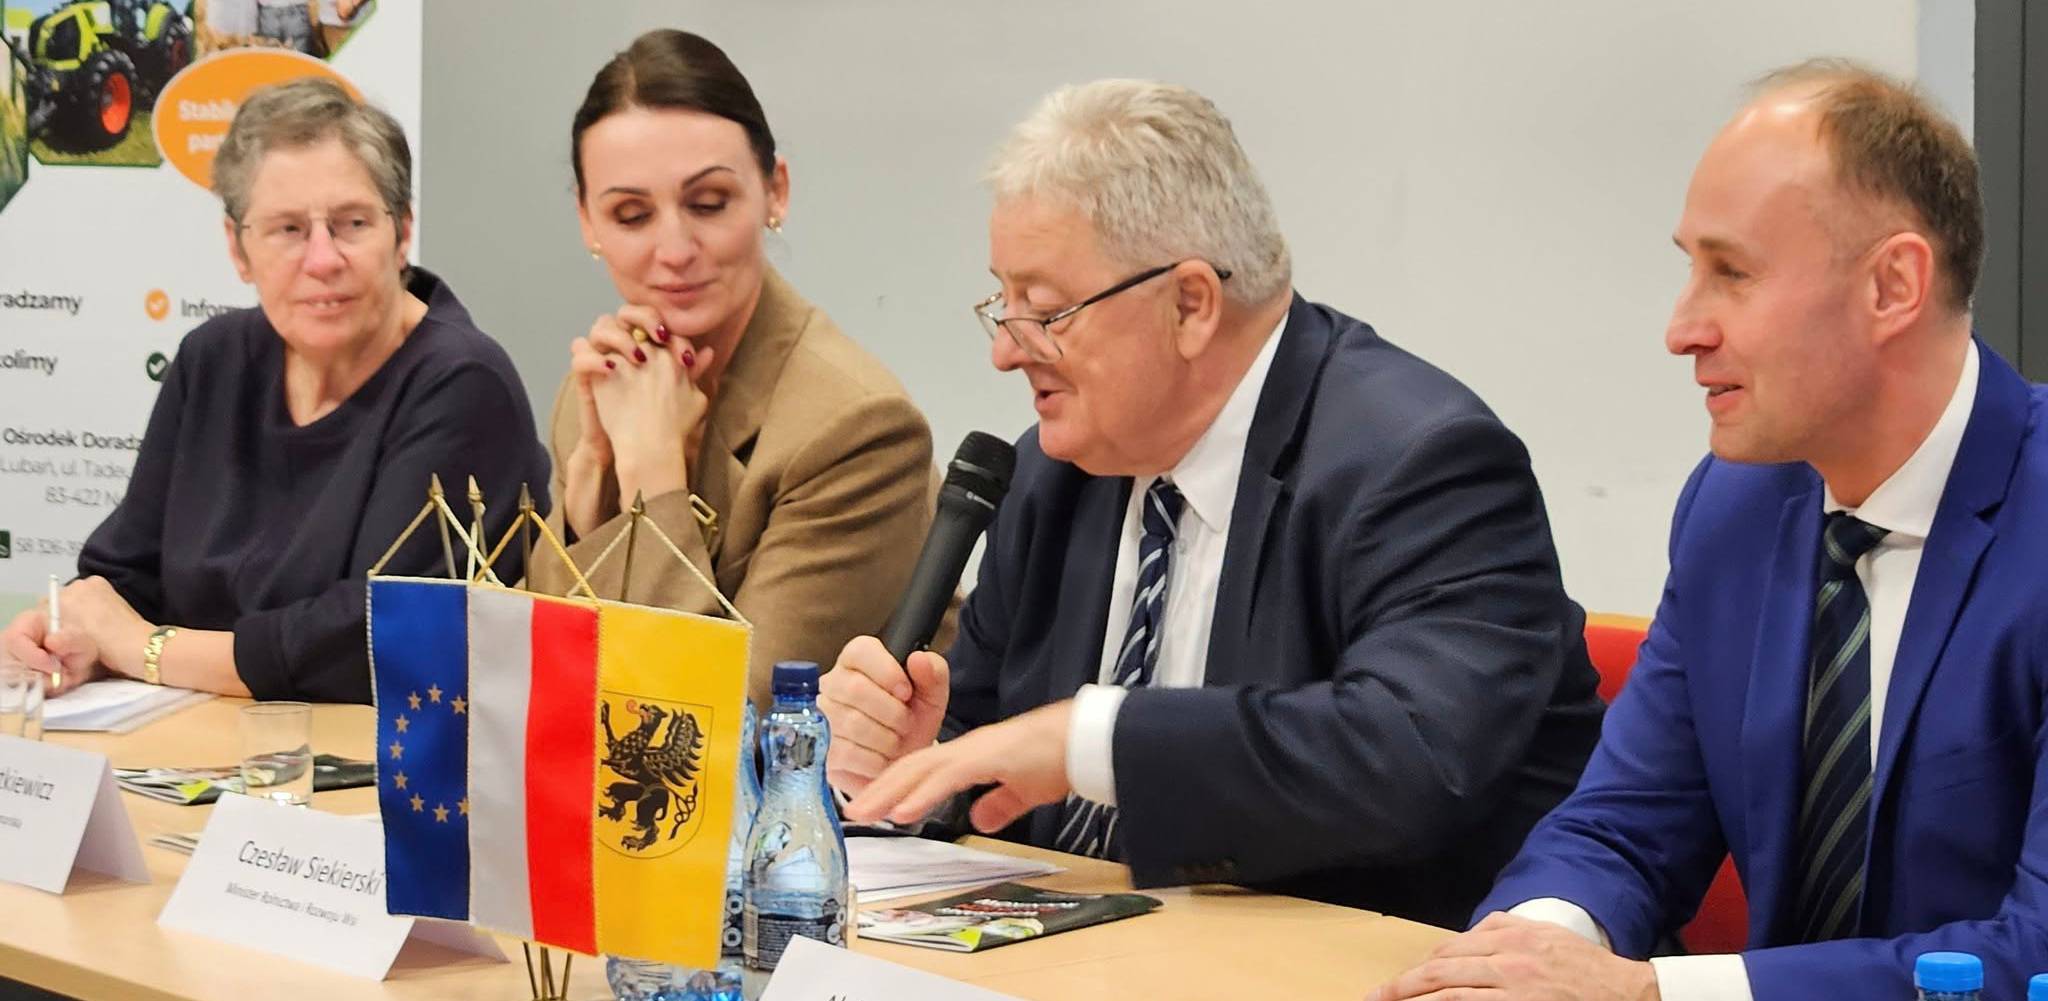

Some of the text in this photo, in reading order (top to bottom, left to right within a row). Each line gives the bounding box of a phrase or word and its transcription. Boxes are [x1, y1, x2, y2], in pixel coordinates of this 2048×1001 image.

[0, 349, 58, 375] olimy
[238, 840, 386, 896] Czesław Siekierski
